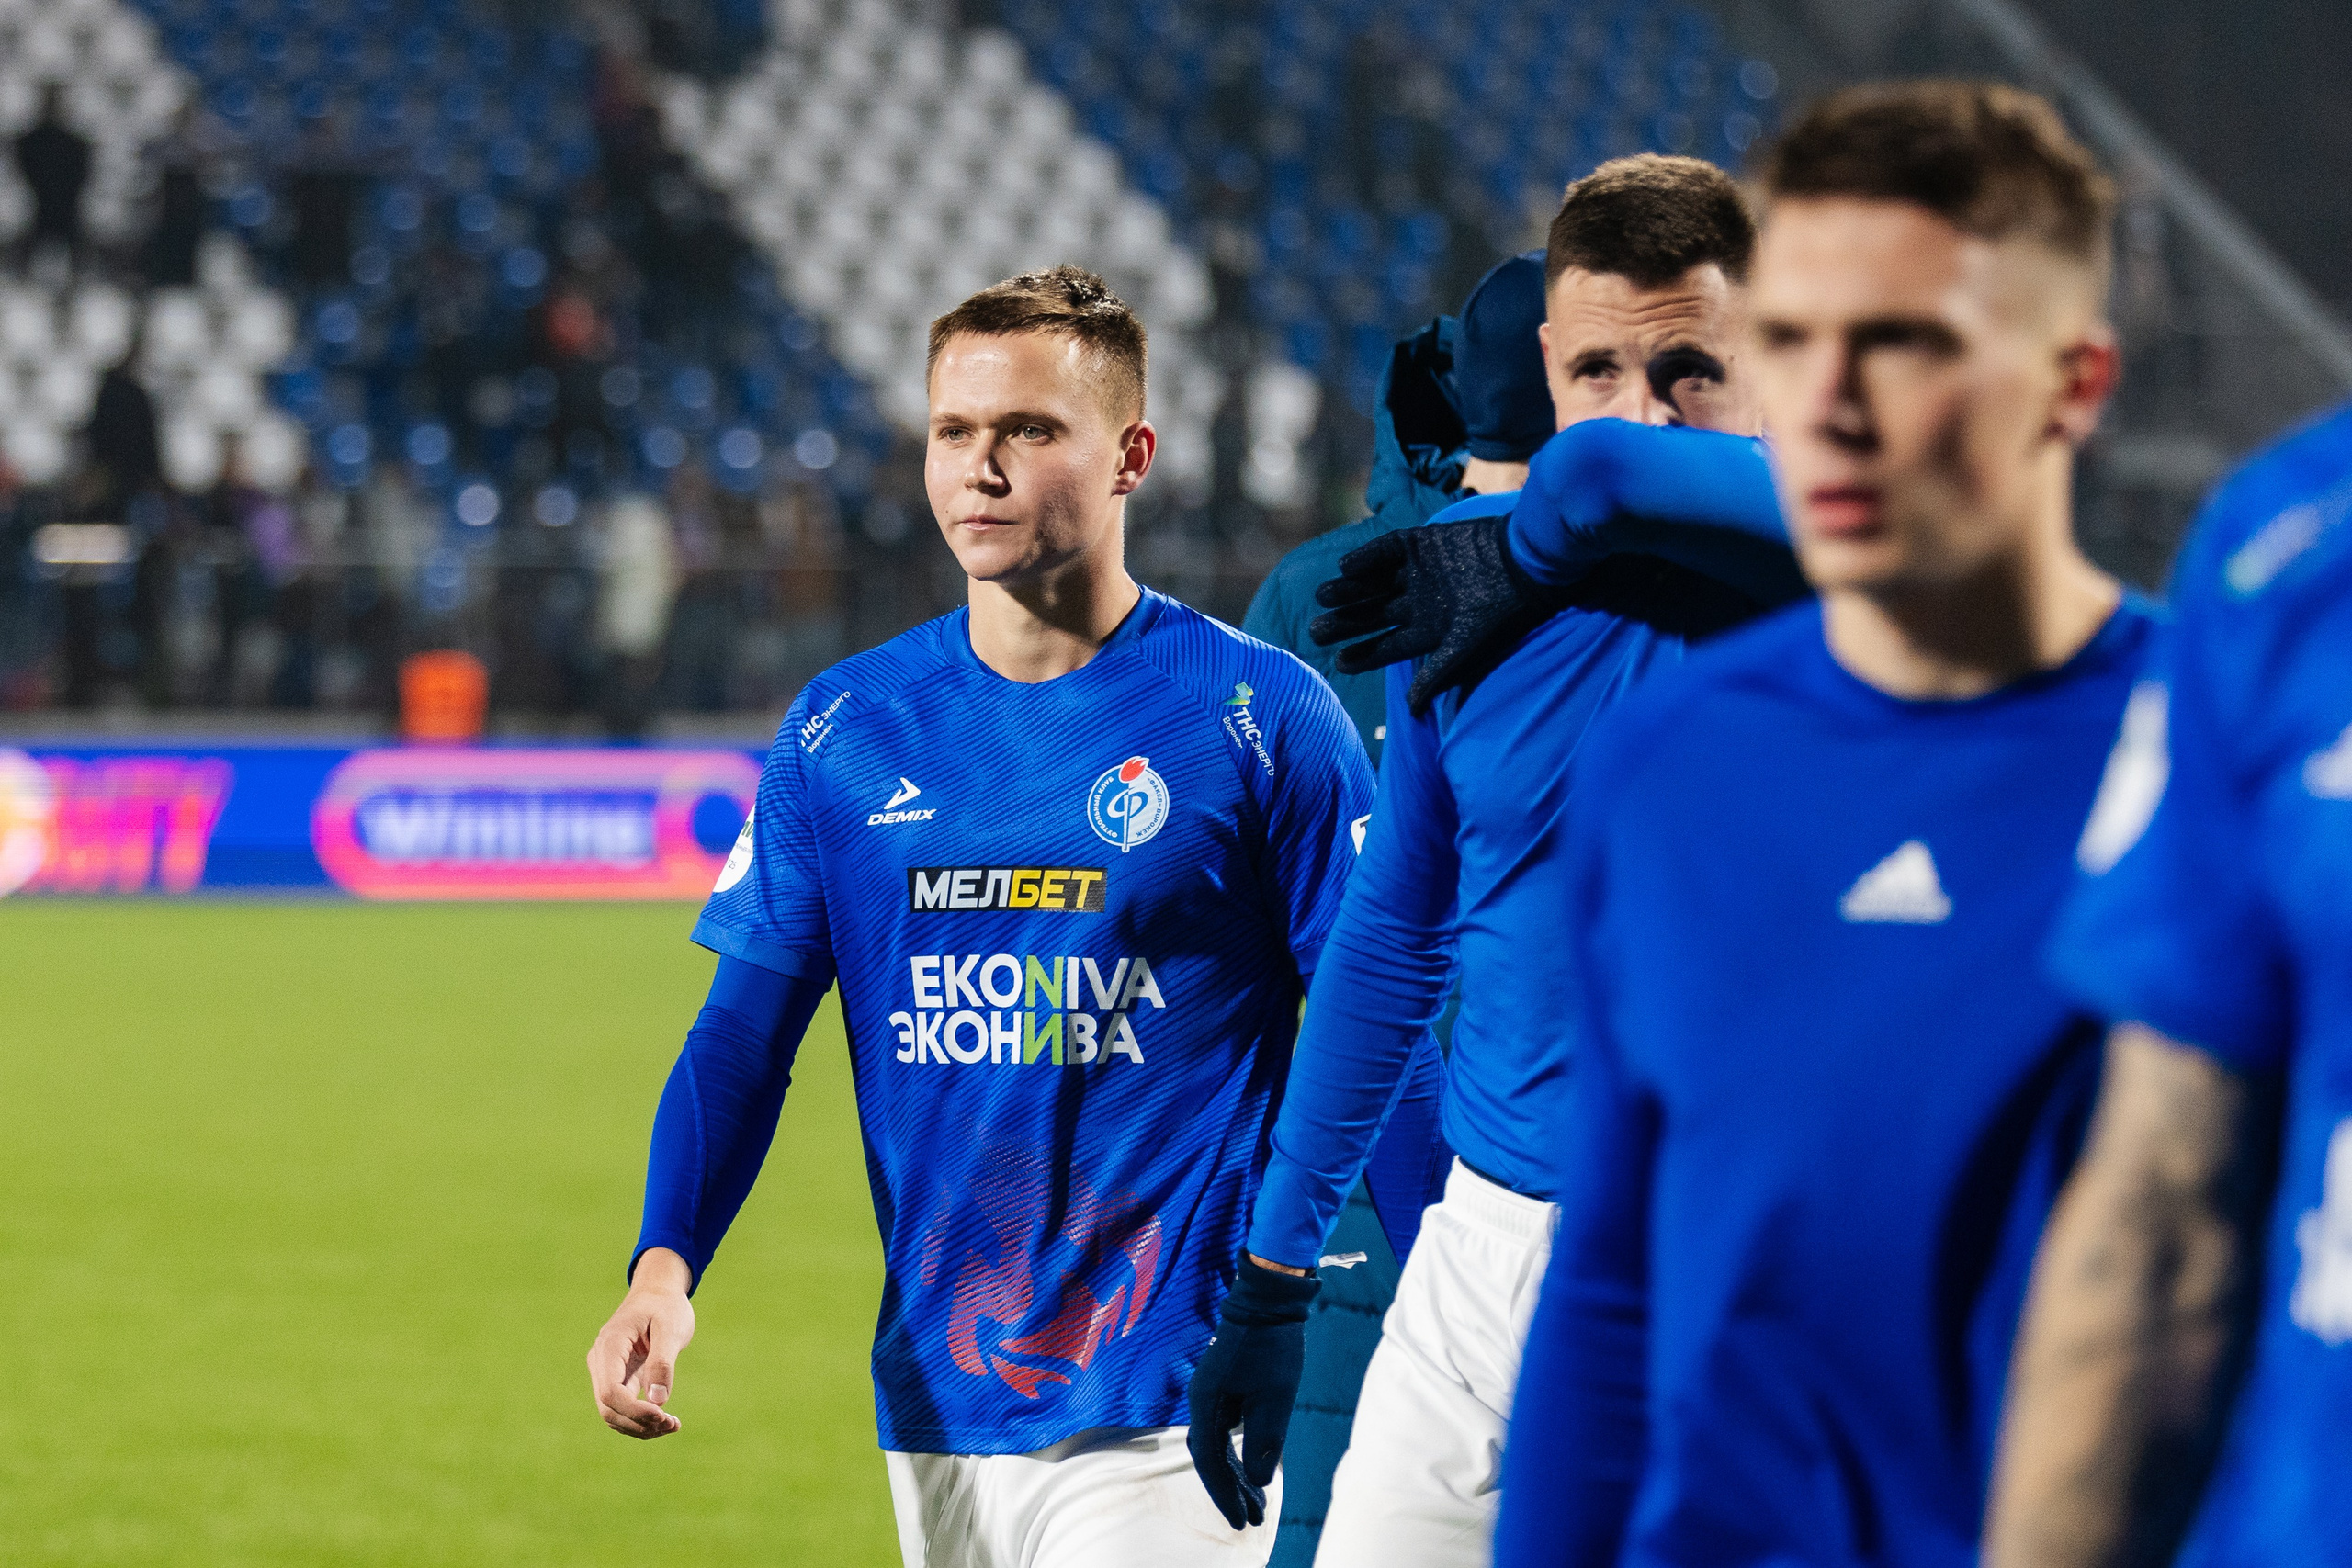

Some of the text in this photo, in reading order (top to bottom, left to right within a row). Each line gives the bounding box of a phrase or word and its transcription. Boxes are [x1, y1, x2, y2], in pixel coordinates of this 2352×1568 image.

[800, 715, 824, 748] НС
[1233, 706, 1261, 741] ТНС
[1097, 775, 1114, 795] КЛУБ
[867, 808, 937, 826] DEMIX
[1136, 808, 1163, 838] ВОРОНЕЖ
[913, 869, 1103, 909] МЕЛБЕТ
[910, 953, 1166, 1010] EKONIVA
[888, 1010, 1145, 1066] ЭКОНИВА
